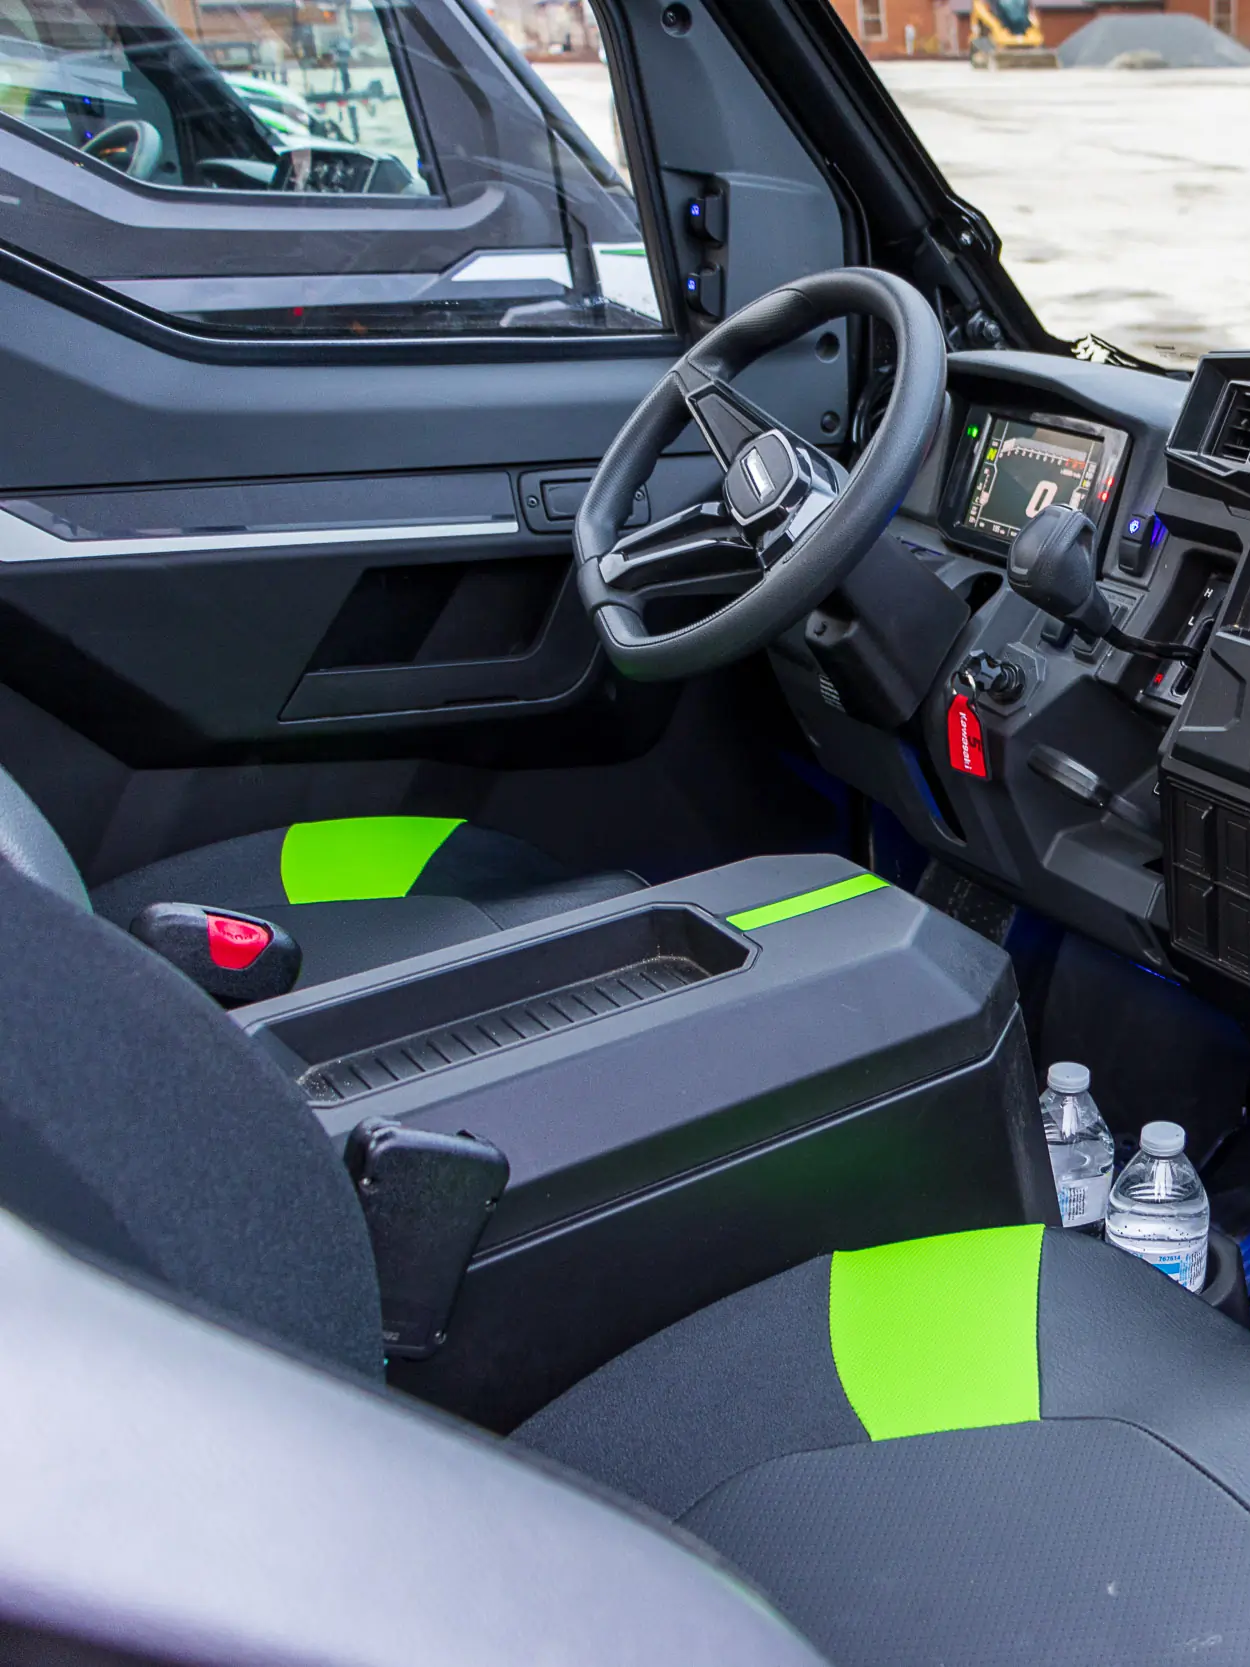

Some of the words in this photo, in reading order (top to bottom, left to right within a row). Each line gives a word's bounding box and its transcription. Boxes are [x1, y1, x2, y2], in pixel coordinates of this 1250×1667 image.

[1025, 480, 1058, 519] 0
[1203, 587, 1214, 598] H
[1187, 616, 1195, 626] L
[959, 711, 972, 770] Kawasaki
